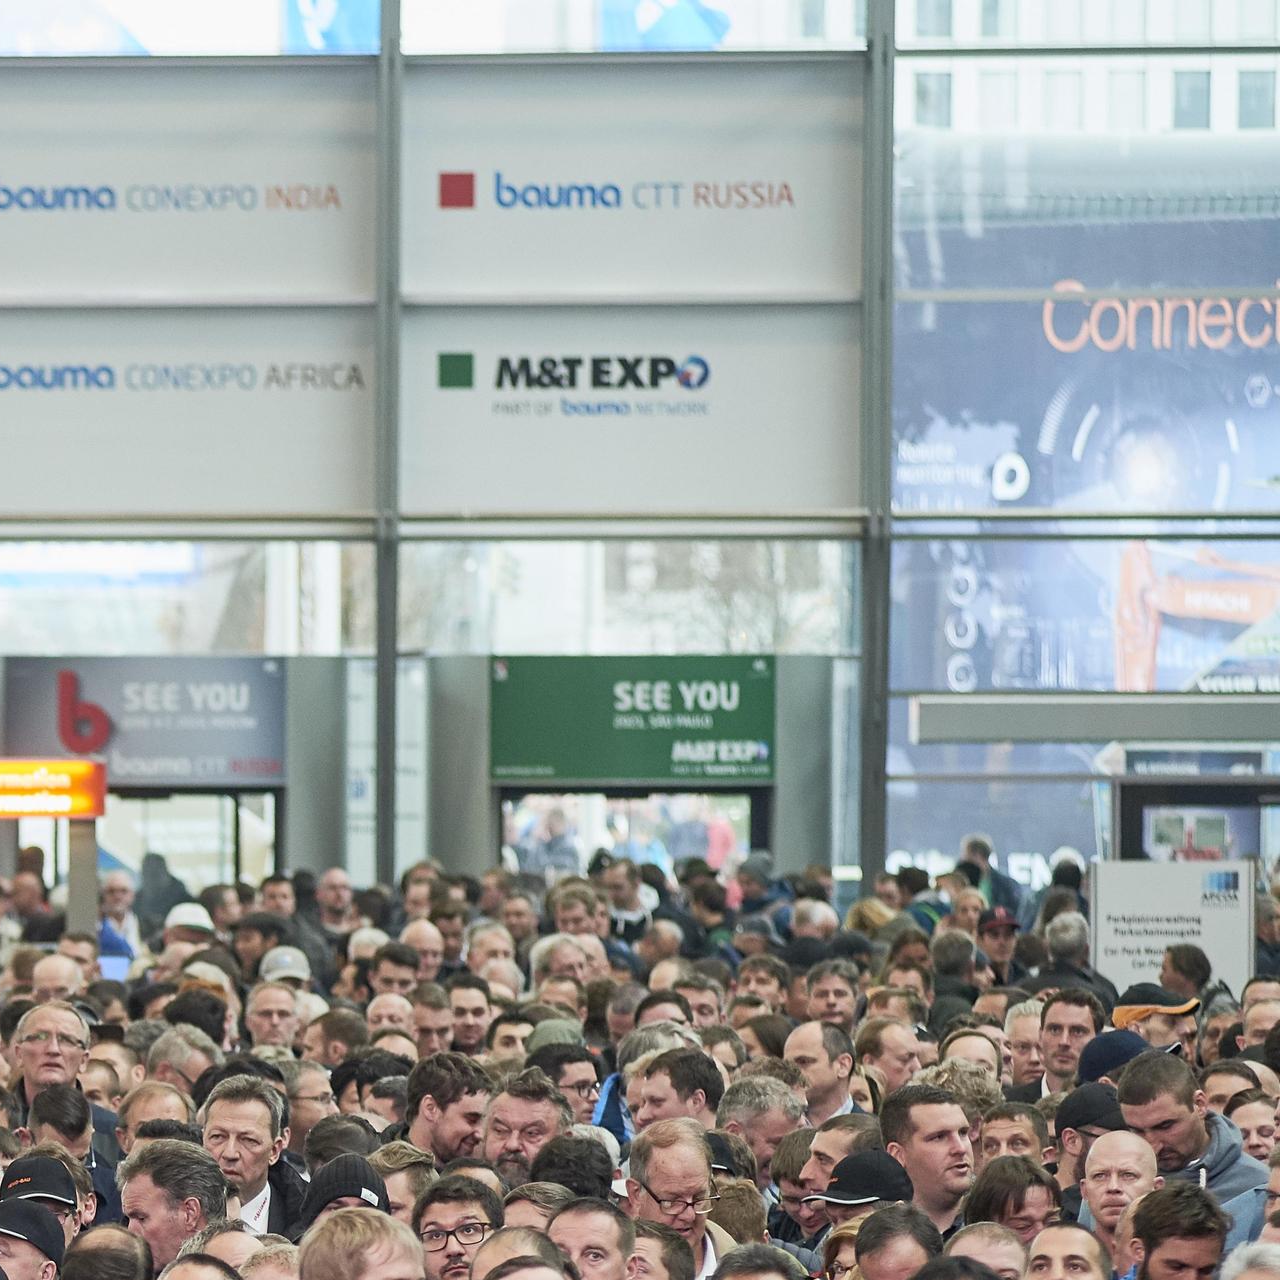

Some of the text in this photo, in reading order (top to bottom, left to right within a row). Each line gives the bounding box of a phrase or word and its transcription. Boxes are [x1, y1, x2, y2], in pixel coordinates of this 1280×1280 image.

[125, 184, 258, 212] CONEXPO
[265, 184, 342, 211] INDIA
[495, 171, 795, 209] bauma CTT RUSSIA
[125, 364, 257, 392] CONEXPO
[263, 363, 365, 391] AFRICA
[496, 356, 711, 390] M&T EXPO
[122, 682, 250, 712] SEE YOU
[612, 680, 740, 711] SEE YOU
